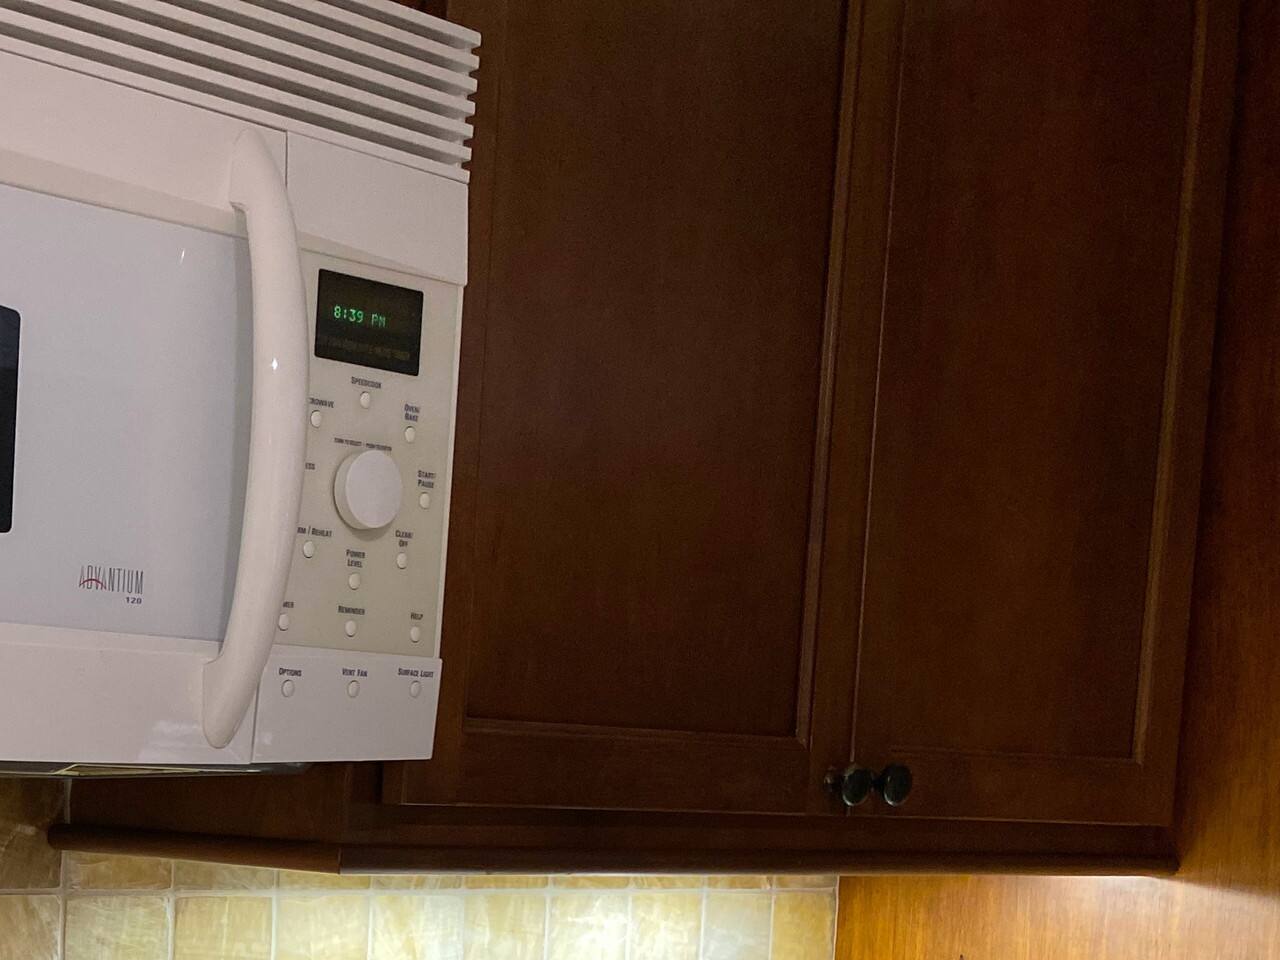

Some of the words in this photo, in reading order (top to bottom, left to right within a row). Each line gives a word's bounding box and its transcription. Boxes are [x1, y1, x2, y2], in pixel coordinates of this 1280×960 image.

[333, 305, 364, 323] 8:39
[371, 313, 386, 328] PM
[346, 550, 365, 559] POWER
[347, 560, 363, 568] LEVEL
[79, 565, 144, 594] ADVANTIUM
[126, 596, 142, 605] 120
[338, 605, 365, 616] REMINDER
[410, 612, 424, 621] HELP
[278, 667, 302, 677] OPTIONS
[342, 667, 356, 677] VENT
[357, 669, 368, 678] FAN
[398, 668, 419, 678] SURFACE
